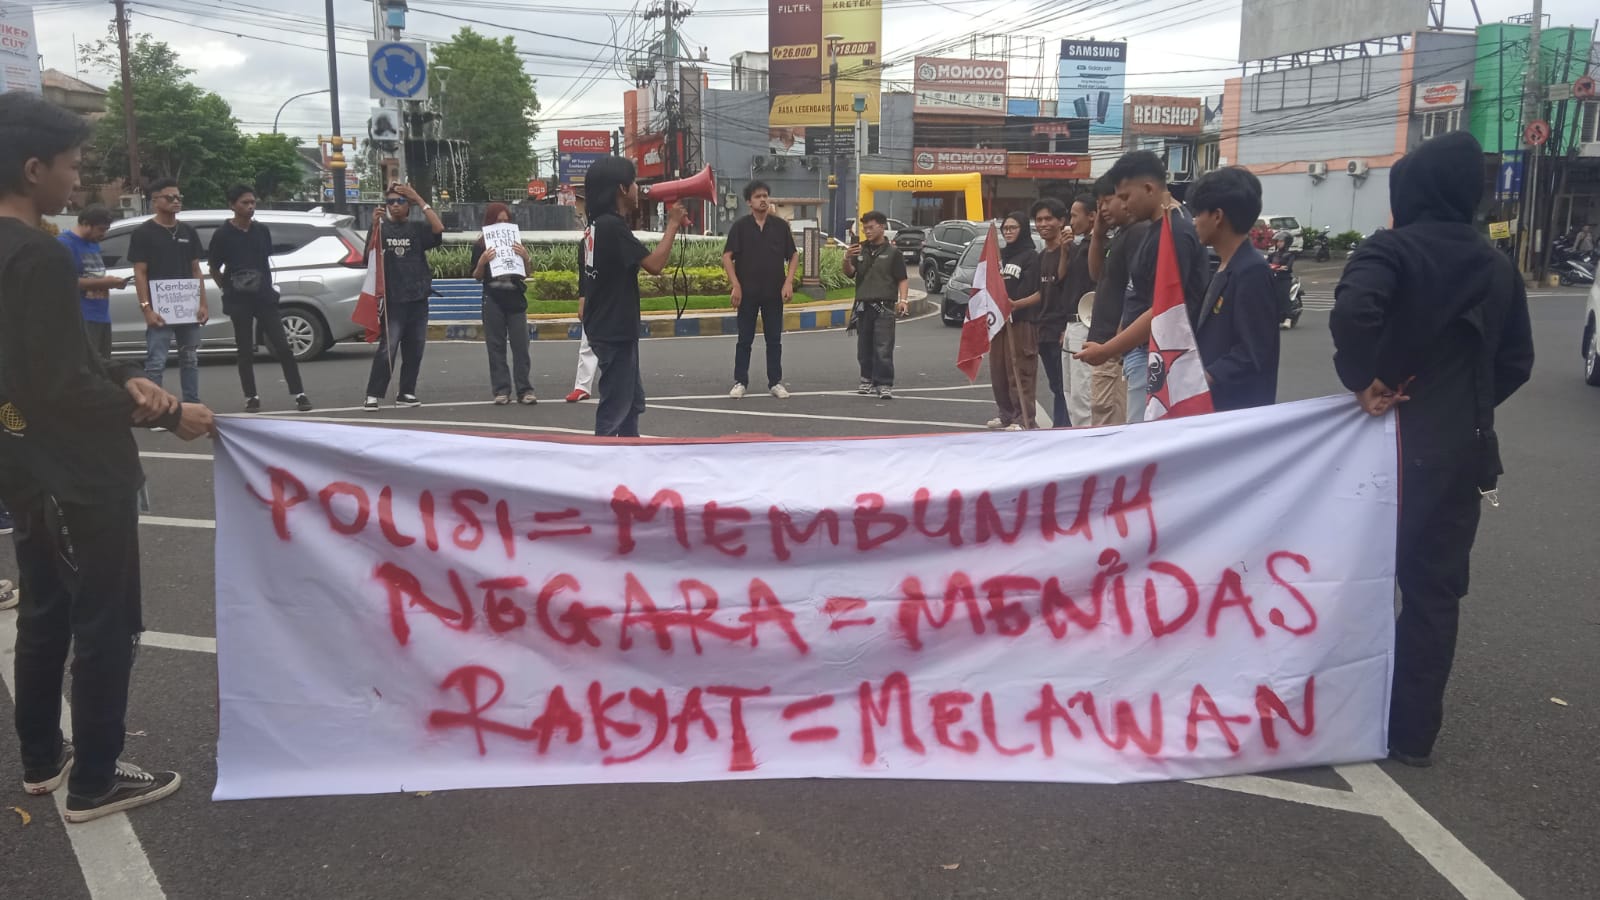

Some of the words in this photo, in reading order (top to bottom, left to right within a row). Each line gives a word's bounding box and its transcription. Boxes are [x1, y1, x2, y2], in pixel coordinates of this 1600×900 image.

[778, 4, 812, 14] FILTER
[1069, 44, 1120, 58] SAMSUNG
[938, 64, 1004, 79] MOMOYO
[1133, 104, 1199, 126] REDSHOP
[562, 136, 604, 147] erafone
[938, 152, 1004, 164] MOMOYO
[897, 178, 932, 188] realme
[386, 238, 411, 247] TOXIC
[248, 467, 516, 560] POLISI
[610, 462, 1158, 562] MEMBUNUH
[373, 560, 809, 656] NEGARA
[427, 664, 772, 772] RAKYAT
[857, 670, 1316, 765] MELAWAN
